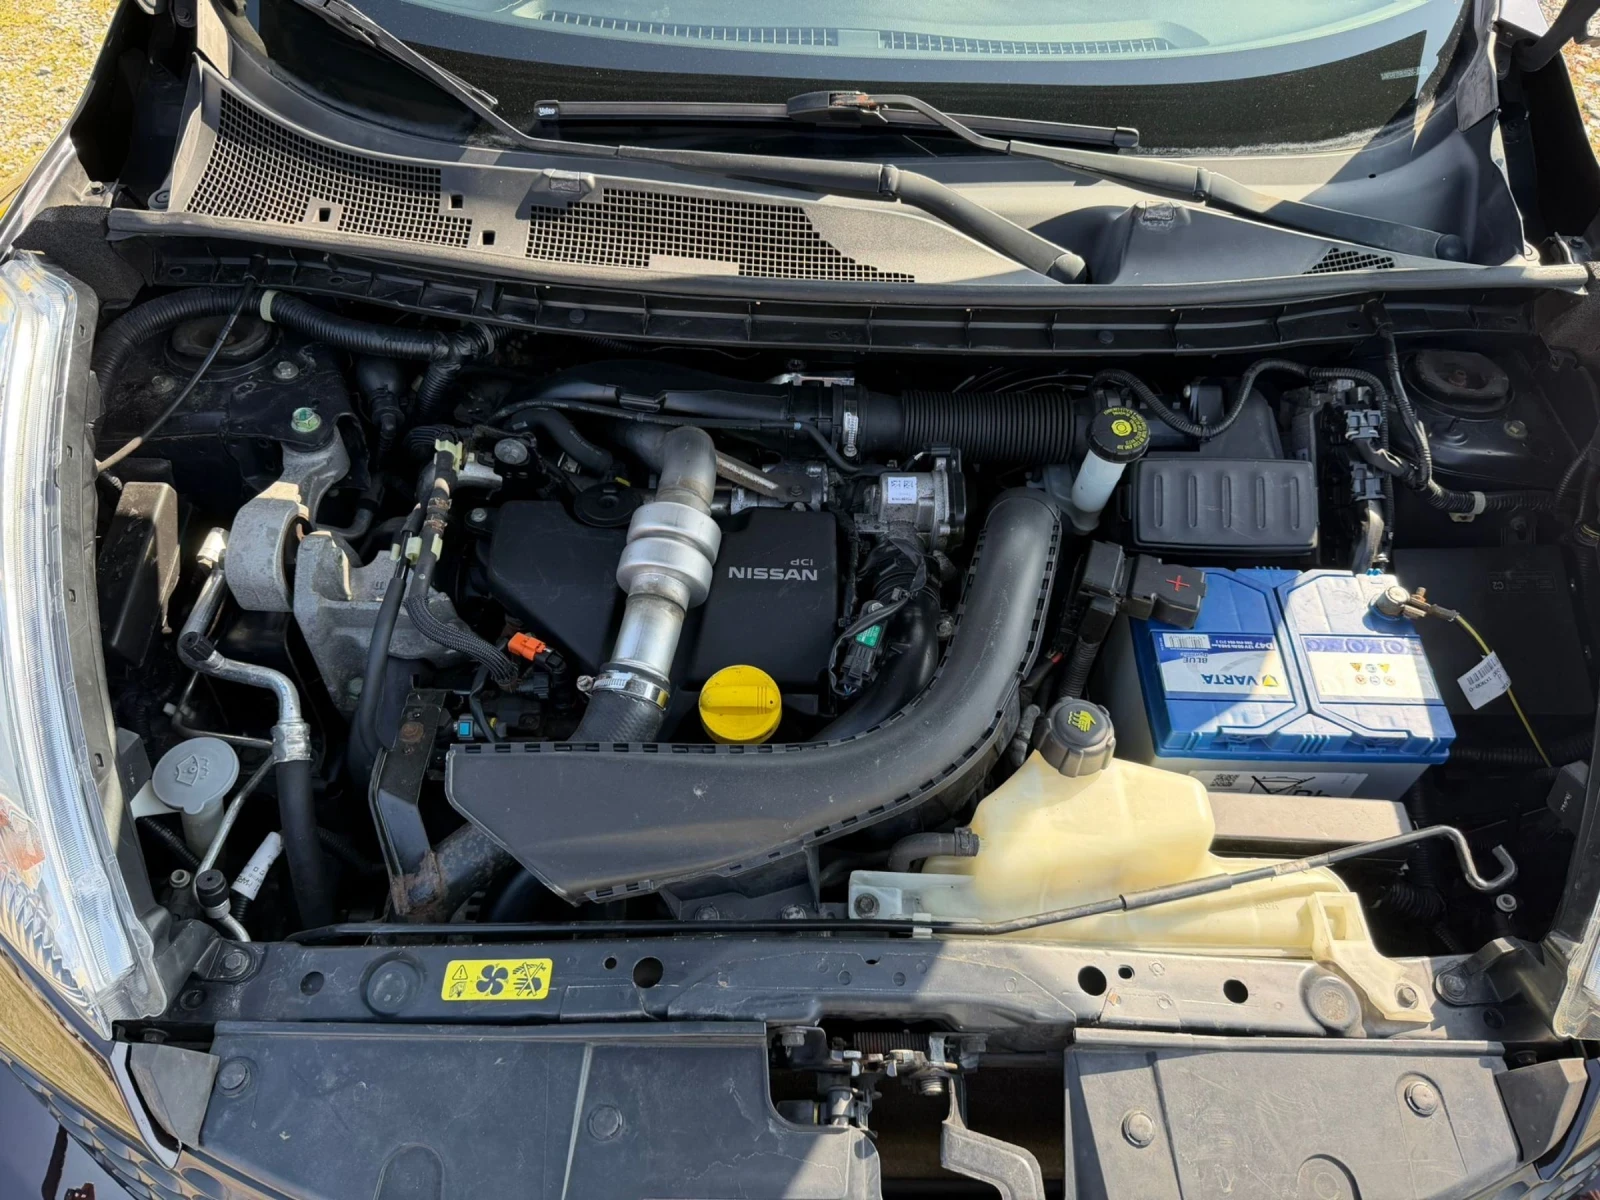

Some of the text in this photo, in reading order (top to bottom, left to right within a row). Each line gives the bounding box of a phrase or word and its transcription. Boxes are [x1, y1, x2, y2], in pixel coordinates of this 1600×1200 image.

[728, 566, 818, 581] NISSAN
[1255, 642, 1274, 650] D47
[1183, 656, 1208, 664] BLUE
[1201, 673, 1259, 686] VARTA
